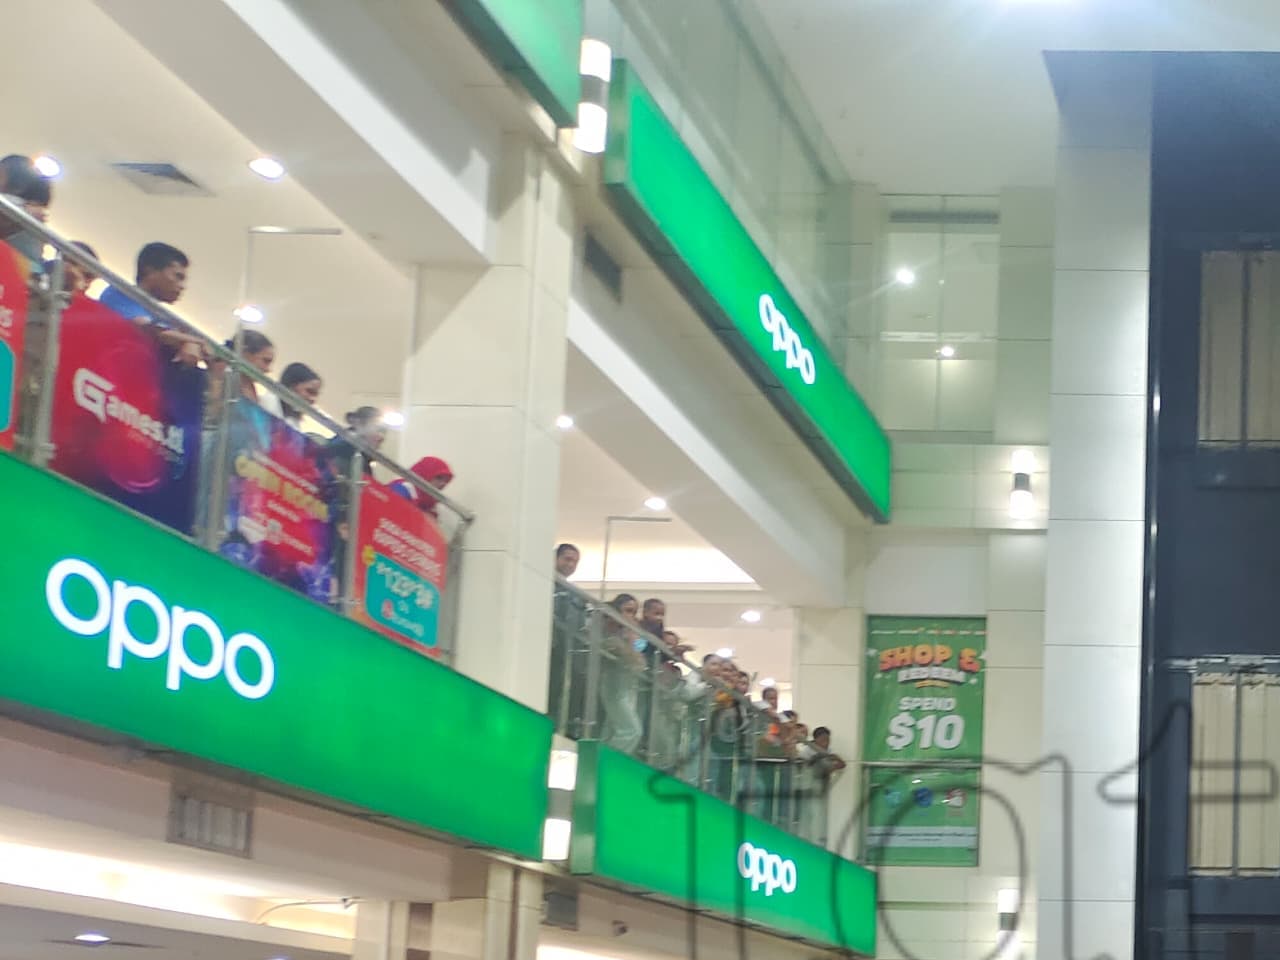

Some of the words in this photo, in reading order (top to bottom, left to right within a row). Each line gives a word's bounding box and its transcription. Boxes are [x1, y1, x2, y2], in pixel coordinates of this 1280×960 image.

[878, 643, 953, 672] SHOP
[958, 647, 982, 673] &
[898, 696, 957, 711] SPEND
[885, 711, 965, 751] $10
